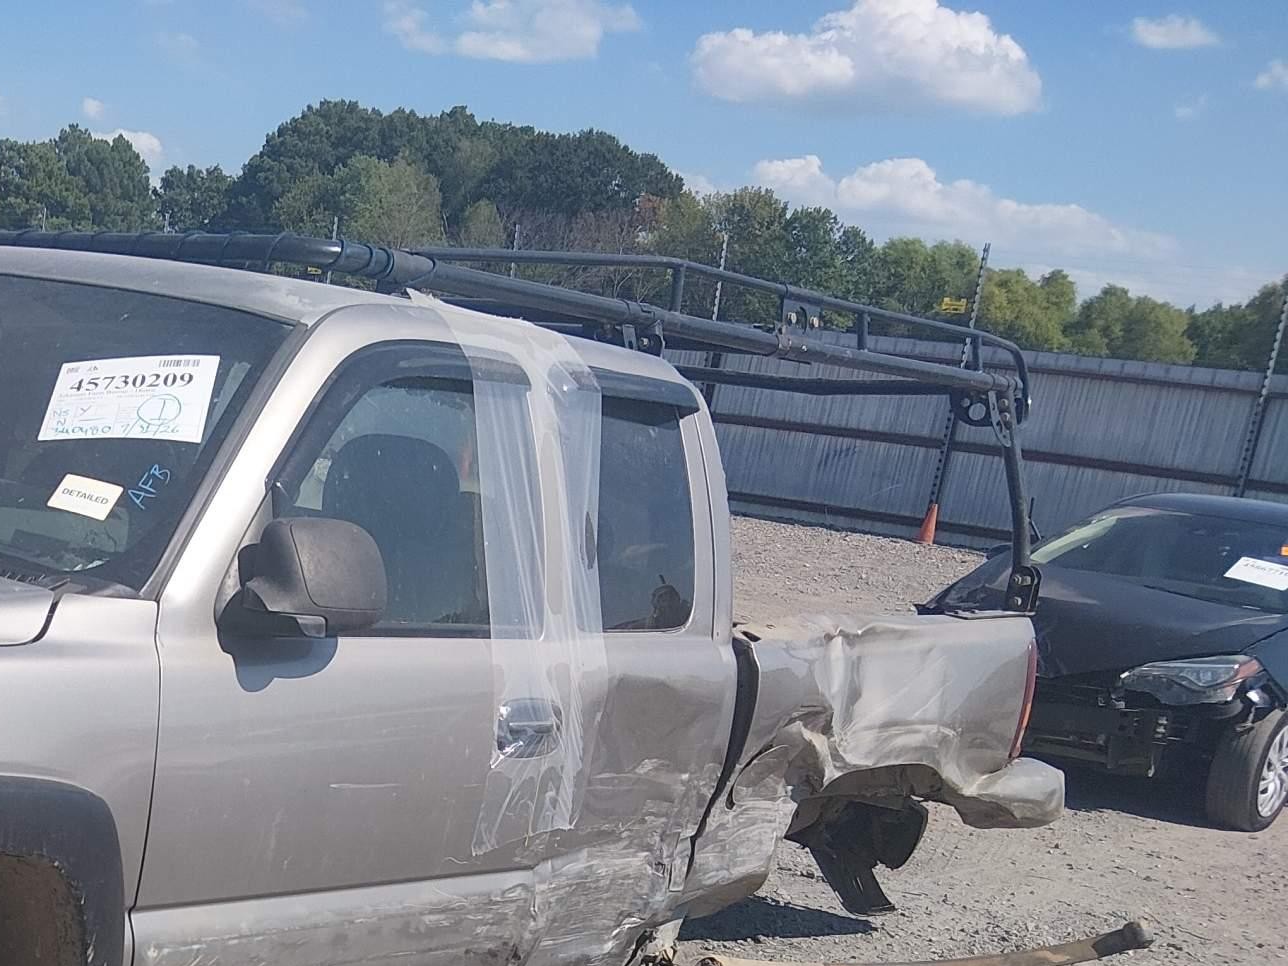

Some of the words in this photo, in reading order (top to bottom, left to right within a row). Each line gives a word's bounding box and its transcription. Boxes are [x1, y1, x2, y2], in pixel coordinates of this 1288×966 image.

[69, 372, 194, 392] 45730209
[62, 487, 110, 506] DETAILED
[128, 464, 171, 510] AFB
